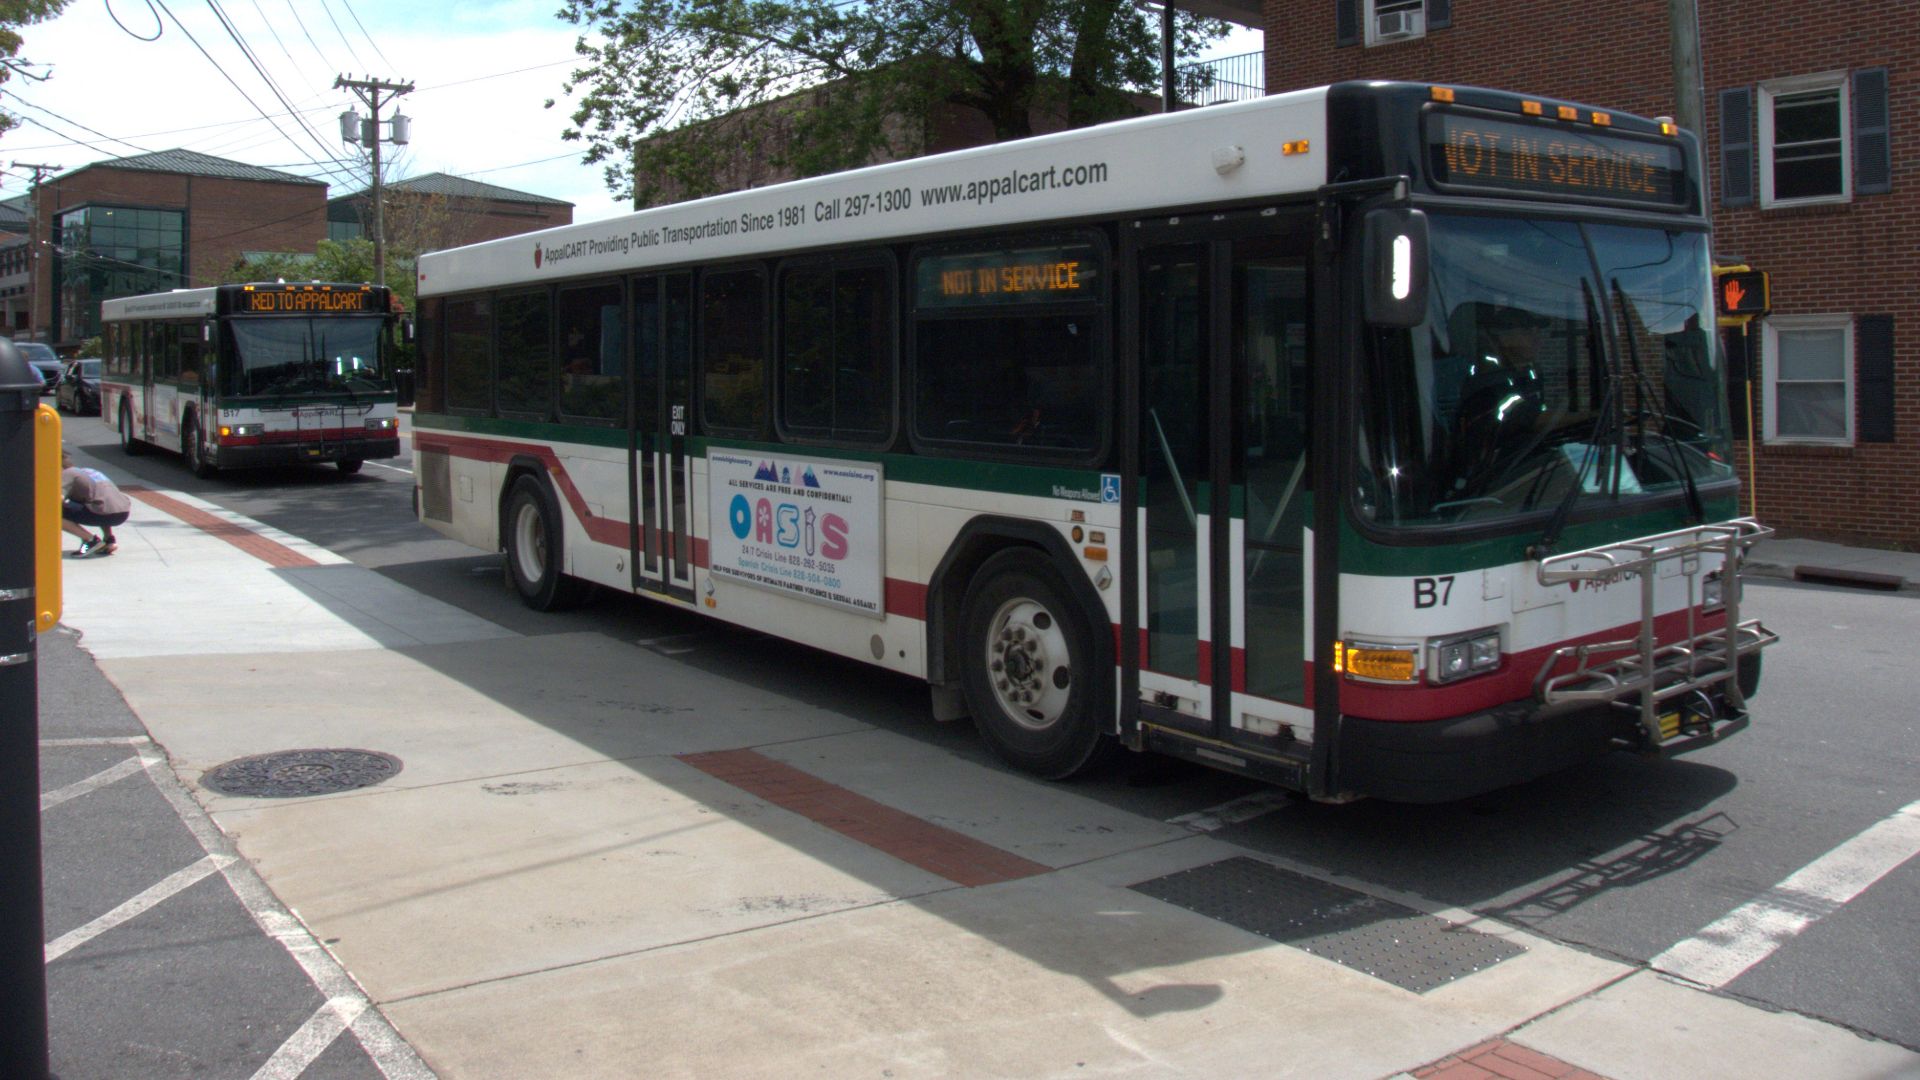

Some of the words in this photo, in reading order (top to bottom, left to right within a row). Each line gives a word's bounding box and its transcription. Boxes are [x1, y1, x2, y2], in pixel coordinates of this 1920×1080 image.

[1512, 135, 1540, 180] IN
[1549, 141, 1656, 193] SERVICE
[544, 240, 588, 265] AppalCART
[589, 235, 629, 256] Providing
[631, 231, 659, 248] Public
[662, 218, 737, 245] Transportation
[741, 212, 774, 233] Since
[777, 205, 806, 228] 1981
[814, 198, 840, 222] Call
[844, 187, 911, 218] 297-1300
[921, 162, 1107, 206] www.appalcart.com
[941, 270, 973, 294] NOT
[976, 267, 998, 293] IN
[1001, 262, 1080, 292] SERVICE
[251, 293, 275, 310] RED
[276, 293, 293, 310] TO
[295, 293, 363, 310] APPALCART
[672, 405, 684, 420] EXIT
[672, 421, 685, 436] ONLY
[739, 480, 764, 491] SERVICES
[765, 484, 777, 493] ARE
[778, 485, 791, 495] FREE
[793, 487, 806, 497] AND
[756, 548, 773, 561] Crisis
[775, 552, 787, 563] Line
[760, 562, 778, 575] Crisis
[1414, 575, 1455, 608] B7
[853, 597, 877, 609] ASSAULT
